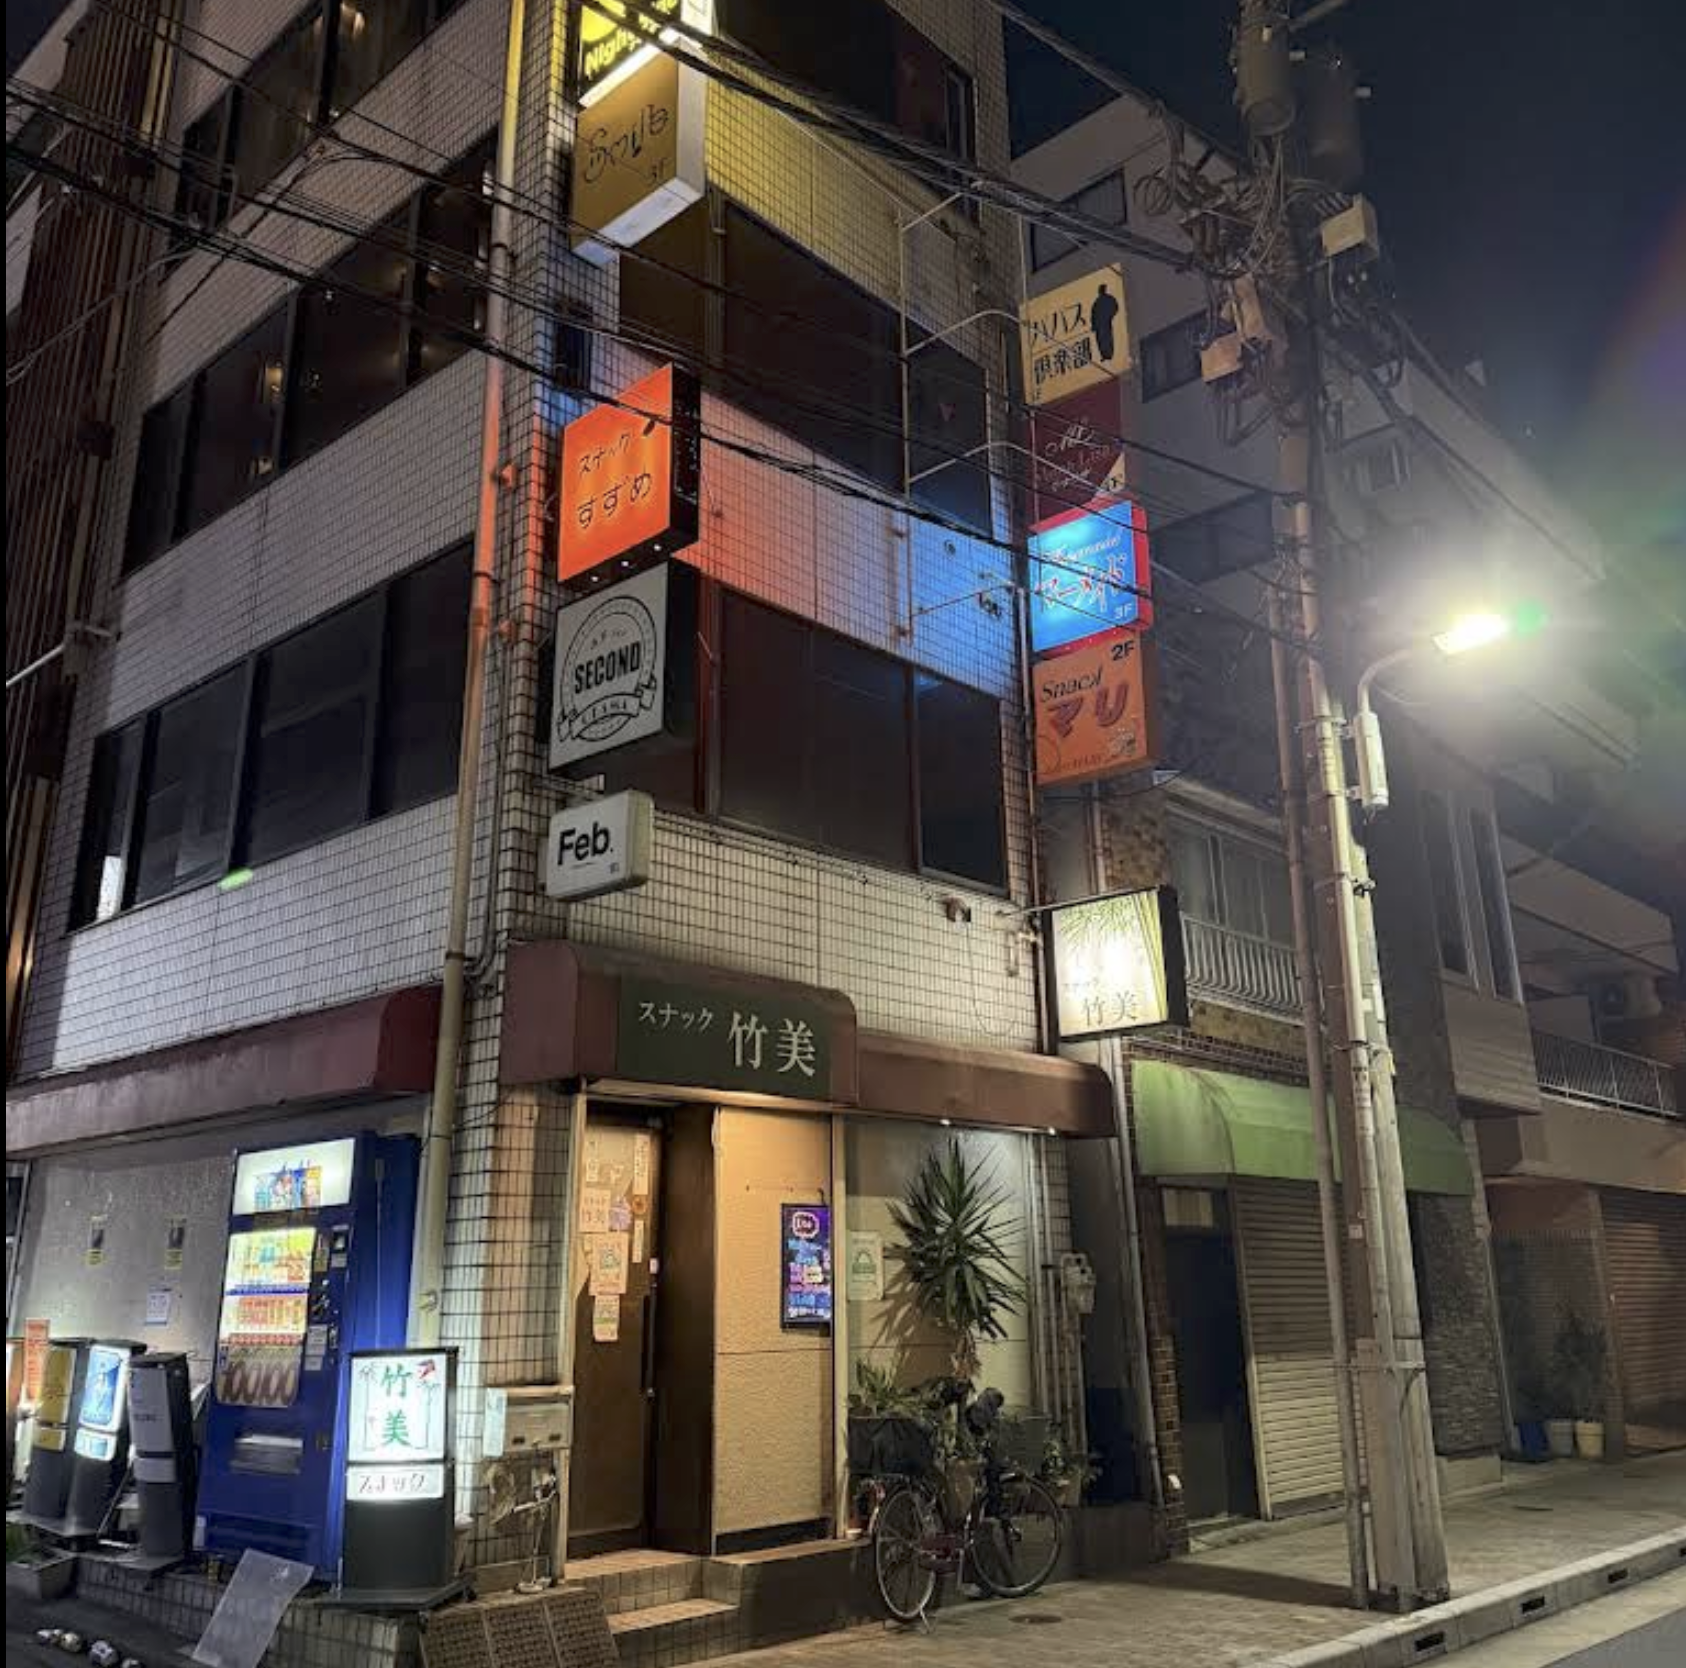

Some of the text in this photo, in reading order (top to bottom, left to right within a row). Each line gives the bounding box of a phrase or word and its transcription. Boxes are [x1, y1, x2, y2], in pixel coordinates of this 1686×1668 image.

[577, 468, 653, 529] すずめ
[574, 641, 641, 694] SECOND
[1111, 641, 1135, 661] 2F
[557, 820, 614, 866] Feb.
[1080, 990, 1138, 1028] 竹美
[638, 1001, 816, 1077] スナック 竹美
[380, 1362, 413, 1448] 竹美
